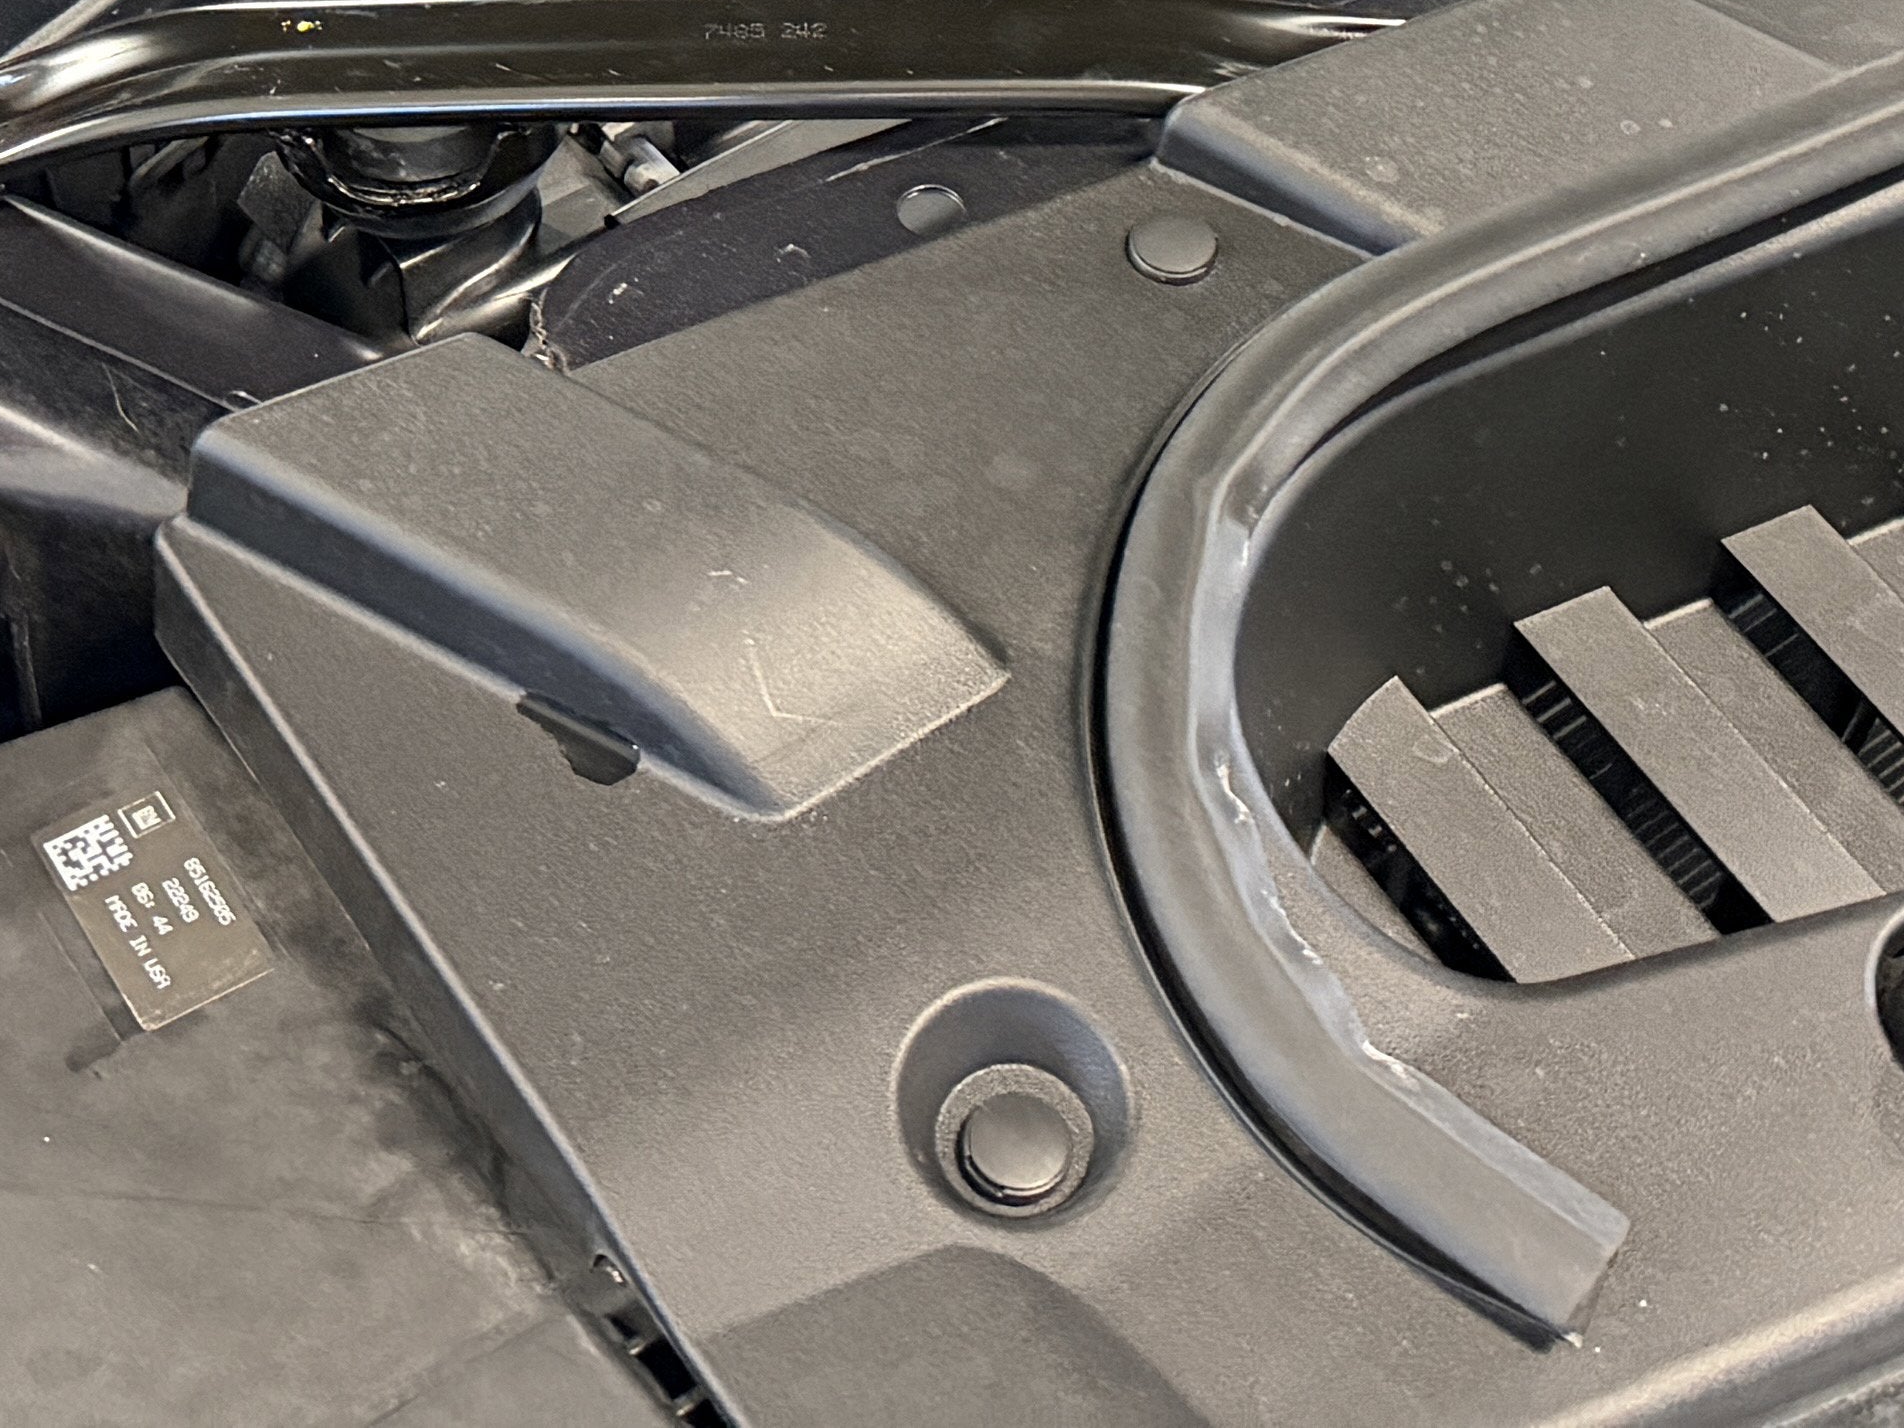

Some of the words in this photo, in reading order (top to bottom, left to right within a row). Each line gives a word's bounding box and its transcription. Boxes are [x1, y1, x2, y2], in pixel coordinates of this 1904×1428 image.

[161, 876, 200, 924] 22249
[104, 894, 139, 933] MADE
[129, 934, 152, 958] IN
[142, 957, 172, 990] USA
